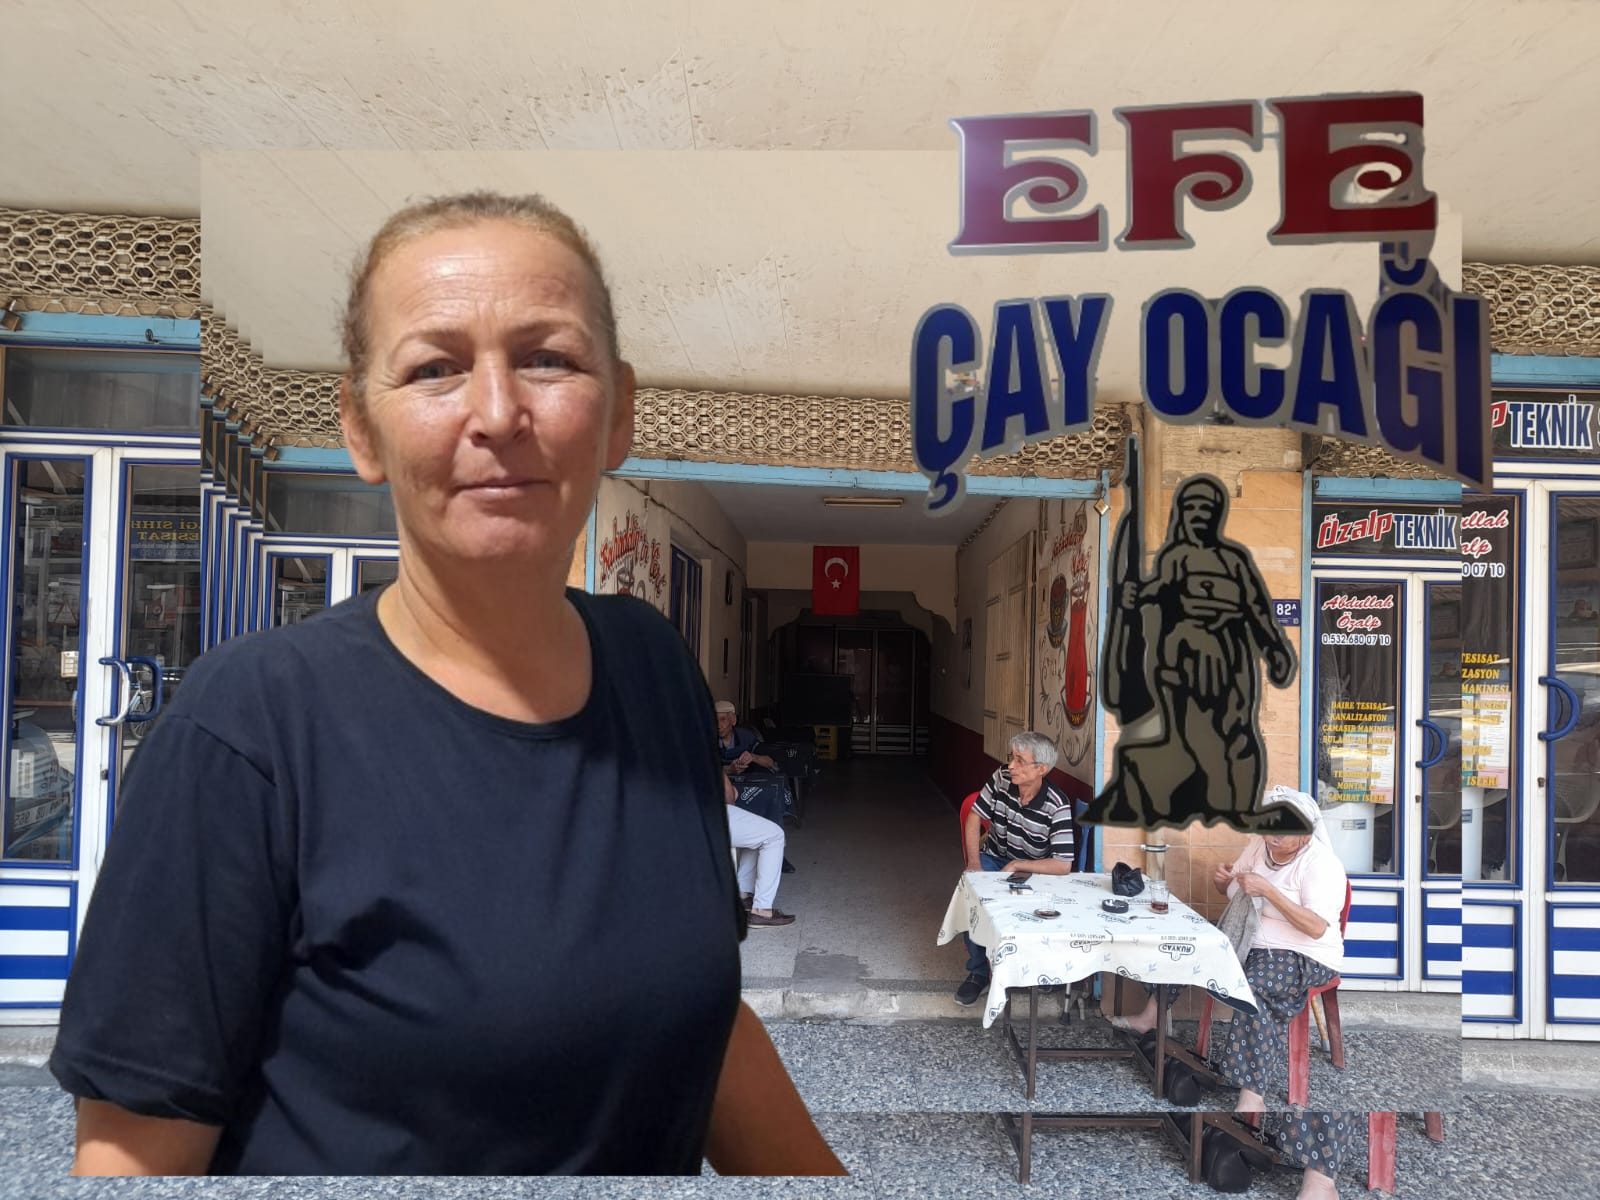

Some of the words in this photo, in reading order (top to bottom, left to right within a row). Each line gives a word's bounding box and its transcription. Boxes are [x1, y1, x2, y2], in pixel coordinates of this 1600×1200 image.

[948, 92, 1438, 254] EFE
[911, 293, 1112, 515] ÇAY
[1142, 245, 1490, 488] OCAĞI
[1508, 394, 1594, 449] TEKNİK
[1316, 509, 1393, 549] Özalp
[1393, 508, 1458, 550] TEKNİK
[1472, 562, 1487, 577] 07
[1489, 563, 1505, 577] 10
[1321, 595, 1394, 610] Abdullah
[1337, 611, 1381, 632] Özalp
[1366, 634, 1377, 645] 07
[1379, 635, 1391, 646] 10
[1461, 668, 1499, 679] ZASYON
